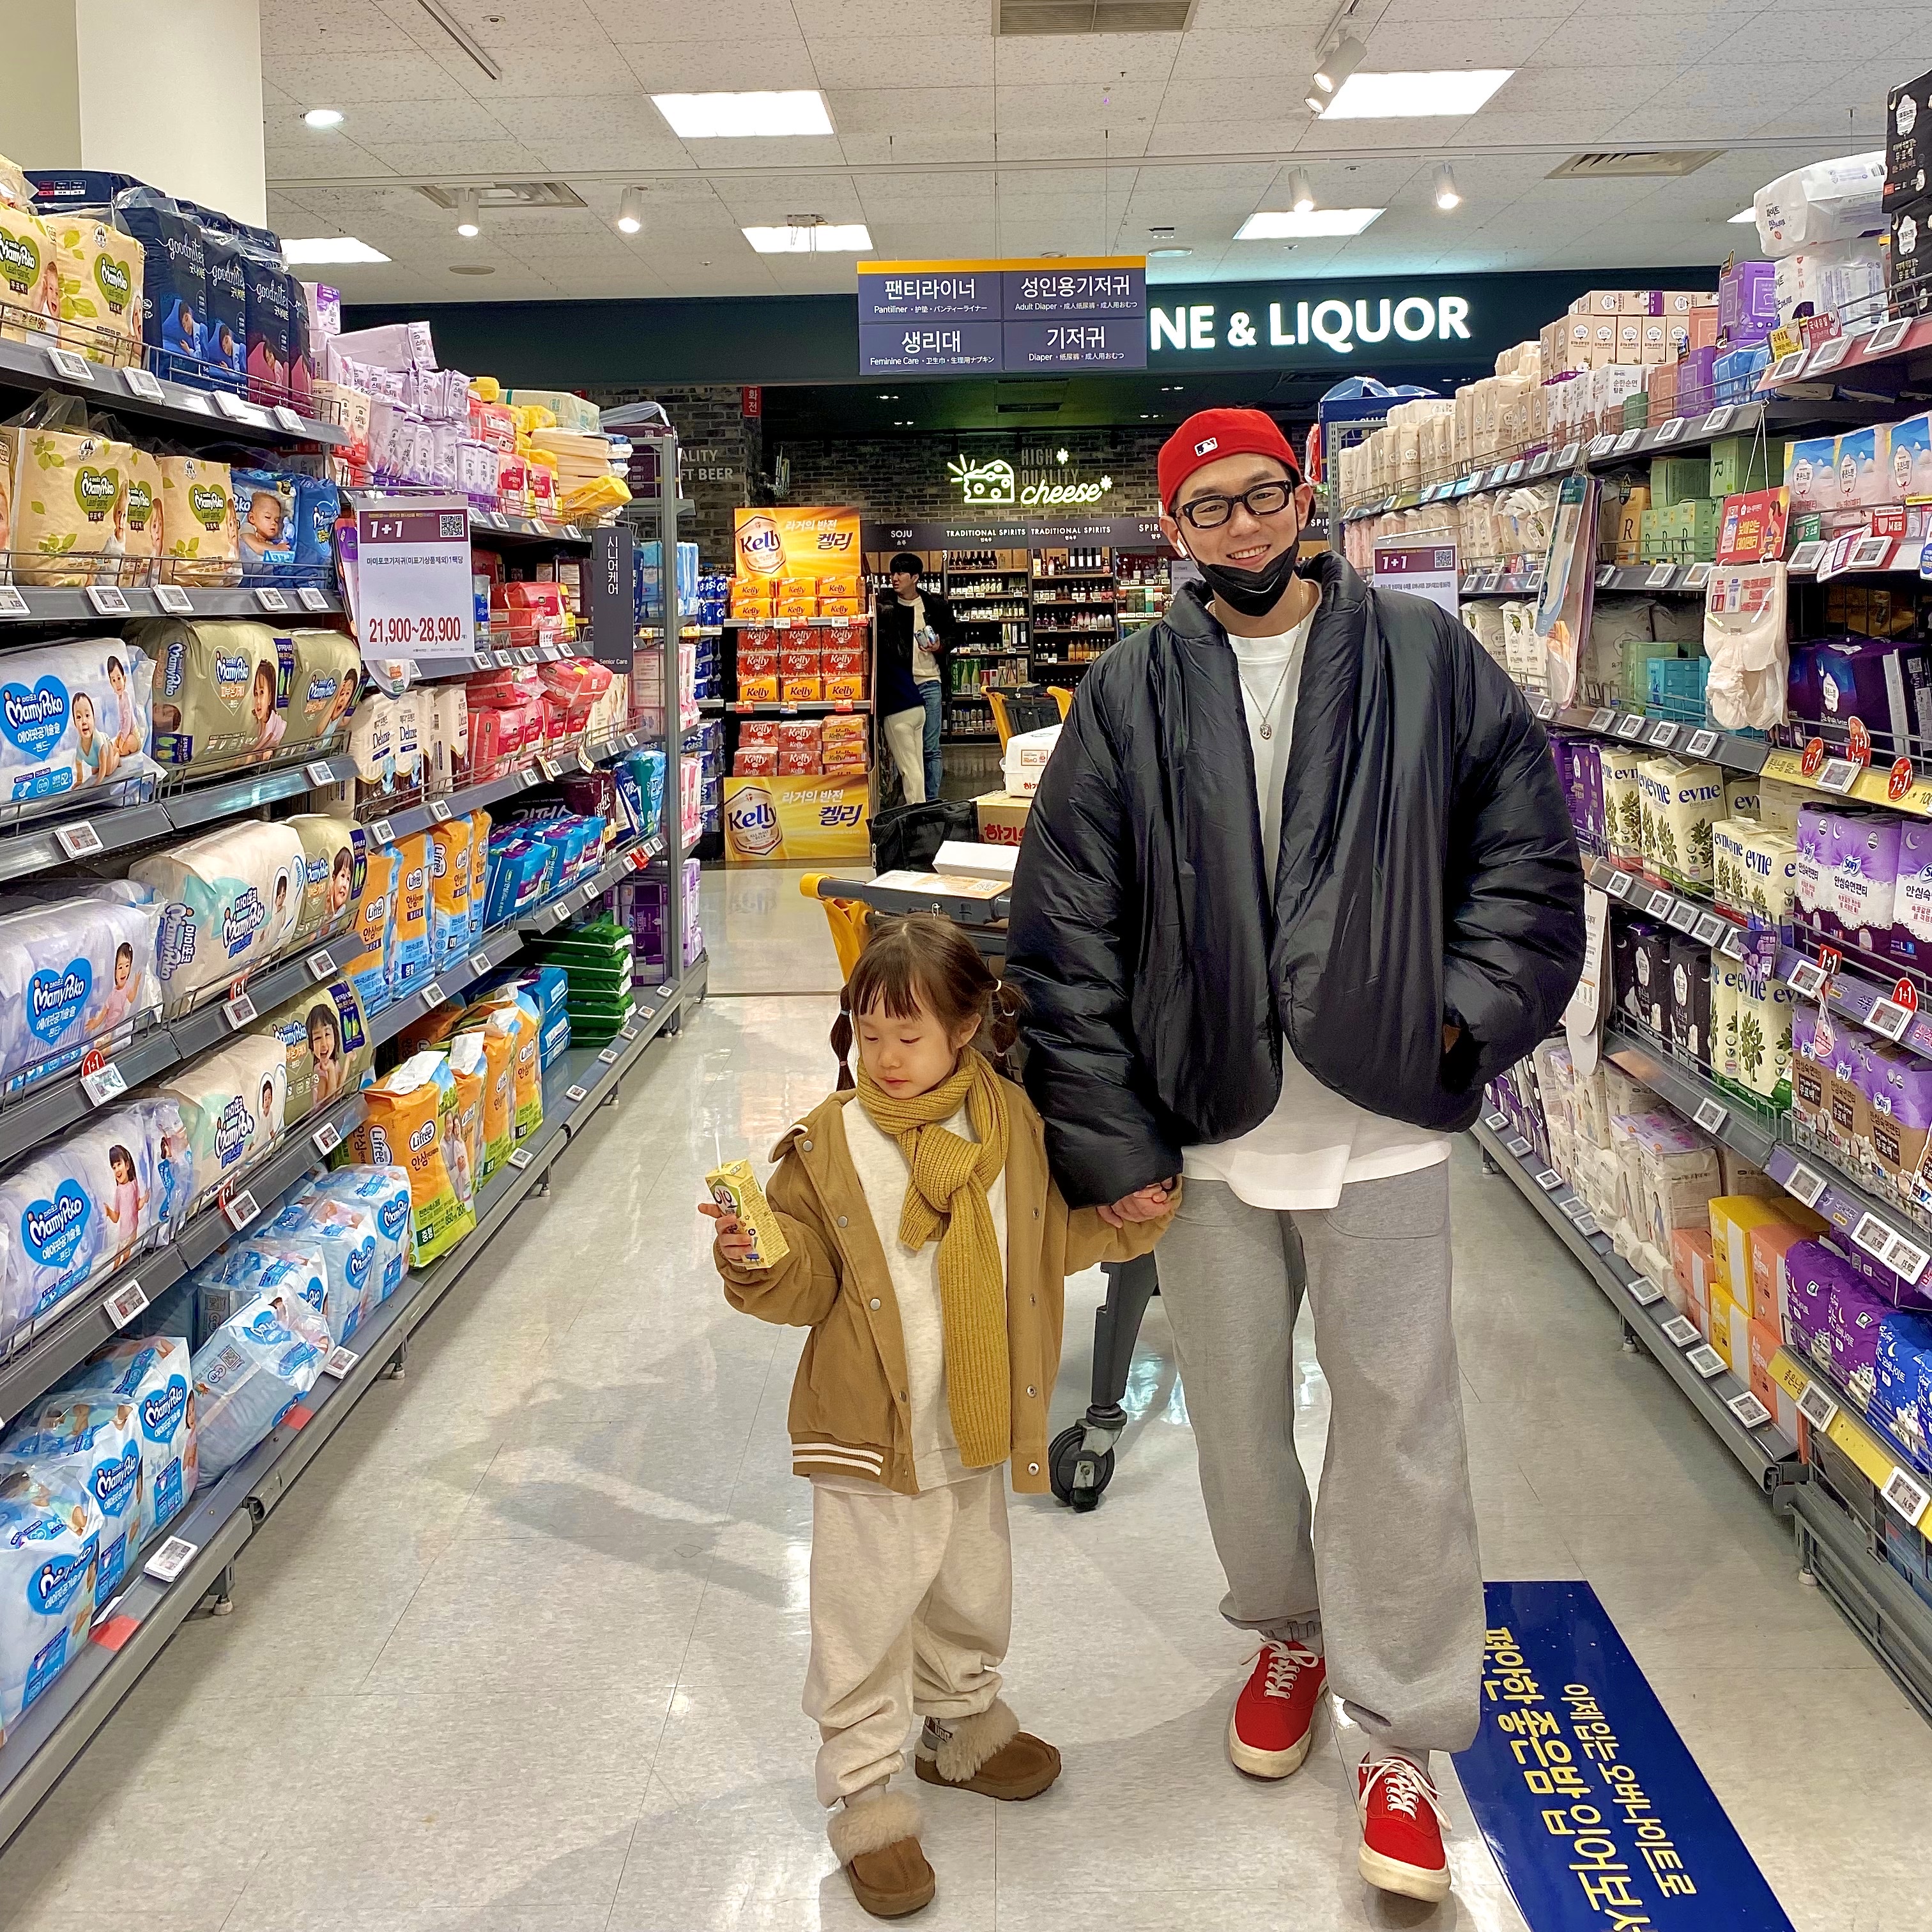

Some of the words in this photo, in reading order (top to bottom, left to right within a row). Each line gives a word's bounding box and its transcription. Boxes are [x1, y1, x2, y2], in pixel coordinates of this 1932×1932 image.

[885, 279, 975, 300] 팬티라이너
[1021, 275, 1130, 298] 성인용기저귀
[874, 305, 908, 314] Pantiliner
[1034, 302, 1057, 311] Diaper
[1227, 311, 1257, 347] &
[1269, 296, 1471, 353] LIQUOR
[901, 330, 961, 354] 생리대
[1046, 326, 1105, 349] 기저귀
[1029, 353, 1052, 362] Diaper
[749, 386, 758, 413] 화전
[1022, 448, 1053, 464] HIGH
[82, 471, 114, 498] MamyPoko
[698, 468, 733, 480] BEER
[1022, 469, 1078, 486] QUALITY
[1021, 479, 1103, 505] cheese
[370, 520, 403, 538] 1+1
[785, 520, 815, 532] 라거의
[817, 519, 838, 530] 반전
[1623, 518, 1633, 540] R
[740, 532, 781, 554] Kelly
[816, 532, 853, 551] 켈리
[1645, 533, 1650, 553] R
[1662, 530, 1667, 553] R
[1682, 527, 1687, 551] R
[608, 536, 619, 595] 시니어케어
[1383, 556, 1407, 569] 1+1
[742, 586, 760, 595] Kelly
[788, 586, 806, 595] Kelly
[369, 617, 461, 646] 21,900~28,900
[747, 631, 769, 641] Kelly
[789, 631, 811, 640] Kelly
[831, 629, 852, 639] Kelly
[165, 642, 187, 697] MamyPoko
[215, 651, 249, 684] MamyPoko
[747, 656, 769, 666] Kelly
[788, 656, 810, 664] Kelly
[831, 654, 852, 664] Kelly
[307, 675, 337, 702] MamyPoko
[747, 687, 769, 698] Kelly
[790, 687, 812, 697] Kelly
[832, 686, 854, 696] Kelly
[4, 688, 64, 730] MamyPoko
[749, 724, 772, 735] Kelly
[788, 728, 811, 738] Kelly
[1855, 726, 1867, 752] 1+1
[744, 755, 767, 764] Kelly
[790, 754, 812, 763] Kelly
[1804, 749, 1821, 770] 1+1
[1890, 770, 1909, 794] 1+1
[782, 791, 817, 804] 라거의
[820, 789, 843, 802] 반전
[1678, 784, 1721, 804] evne
[728, 804, 776, 831] Kelly
[818, 804, 862, 827] 켈리
[1745, 850, 1772, 876] evne
[1844, 859, 1859, 871] SOFY
[1834, 875, 1868, 897] 안심숙면팬티
[367, 901, 383, 919] Lifree
[406, 895, 417, 908] 안심
[222, 900, 264, 949] MamyPoko
[364, 928, 376, 940] 안심
[1821, 949, 1837, 974] 1+1
[34, 974, 84, 1016] MamyPoko
[233, 981, 245, 997] 1+1
[1898, 986, 1912, 1003] 1+1
[87, 1054, 99, 1073] 1+1
[1876, 1096, 1889, 1111] SOFY
[371, 1130, 385, 1163] Lifree
[411, 1123, 435, 1149] Lifree
[411, 1151, 429, 1170] 안심
[222, 1179, 234, 1206] 1+1
[29, 1196, 83, 1245] MamyPoko
[422, 1227, 433, 1243] 중형
[1882, 1356, 1906, 1383] 오버나이트
[1784, 1368, 1805, 1395] 좋은느낌
[146, 1386, 183, 1428] MamyPoko
[98, 1454, 136, 1499] MamyPoko
[1561, 1683, 1605, 1720] 이제
[1574, 1722, 1620, 1761] 입는
[1498, 1708, 1591, 1800] 좋은밤
[1598, 1763, 1697, 1898] 오버나이트로
